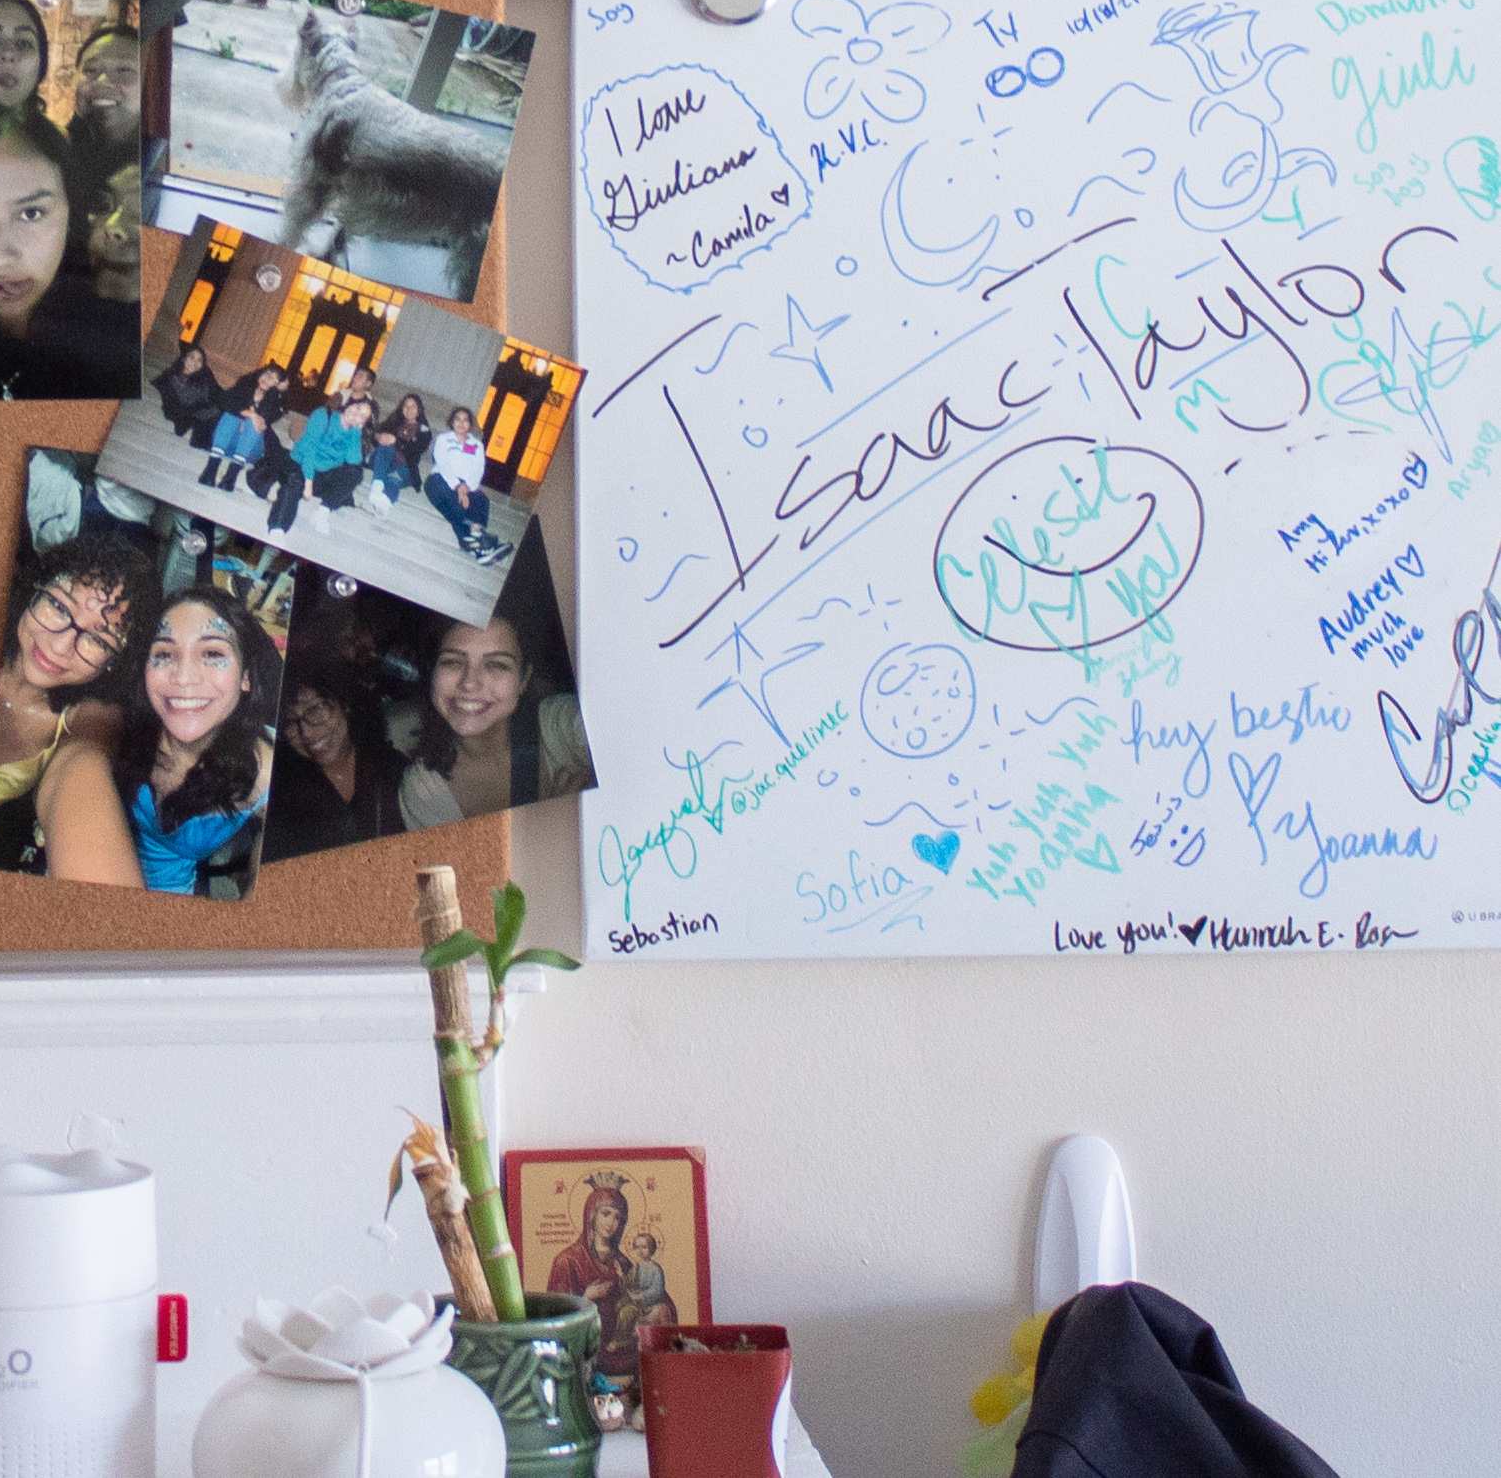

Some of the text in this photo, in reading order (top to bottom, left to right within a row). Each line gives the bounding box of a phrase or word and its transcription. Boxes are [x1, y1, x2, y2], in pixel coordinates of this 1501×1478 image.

[605, 88, 707, 157] I love
[603, 146, 757, 232] Giuliana
[1277, 513, 1332, 553] Amy
[1318, 567, 1404, 655] Audrey
[1351, 611, 1407, 661] much
[1382, 625, 1425, 669] love
[1120, 699, 1217, 799] hey
[796, 849, 914, 924] Sofia
[608, 911, 719, 954] Sebastian
[1054, 919, 1107, 952] Love
